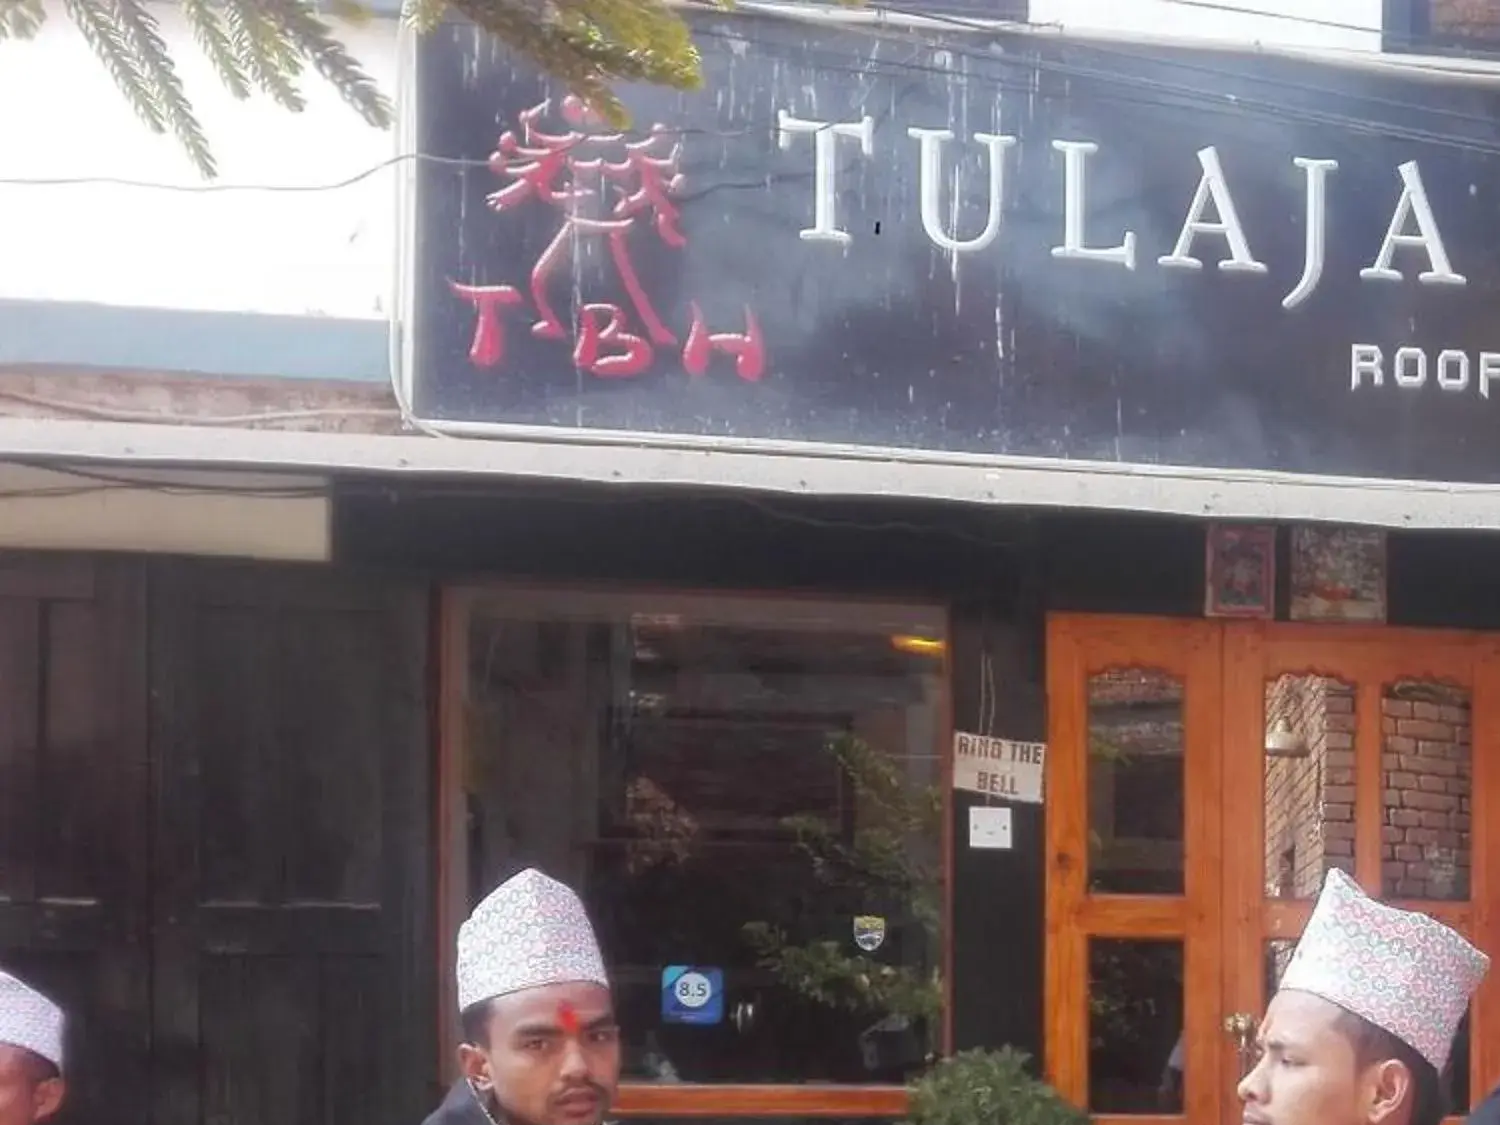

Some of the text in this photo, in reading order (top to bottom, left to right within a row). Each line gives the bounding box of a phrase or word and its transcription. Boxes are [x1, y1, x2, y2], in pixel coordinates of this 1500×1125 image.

[777, 108, 1467, 310] TULAJA
[958, 734, 1042, 765] RING THE
[977, 770, 1019, 795] BELL
[679, 981, 707, 997] 8.5
